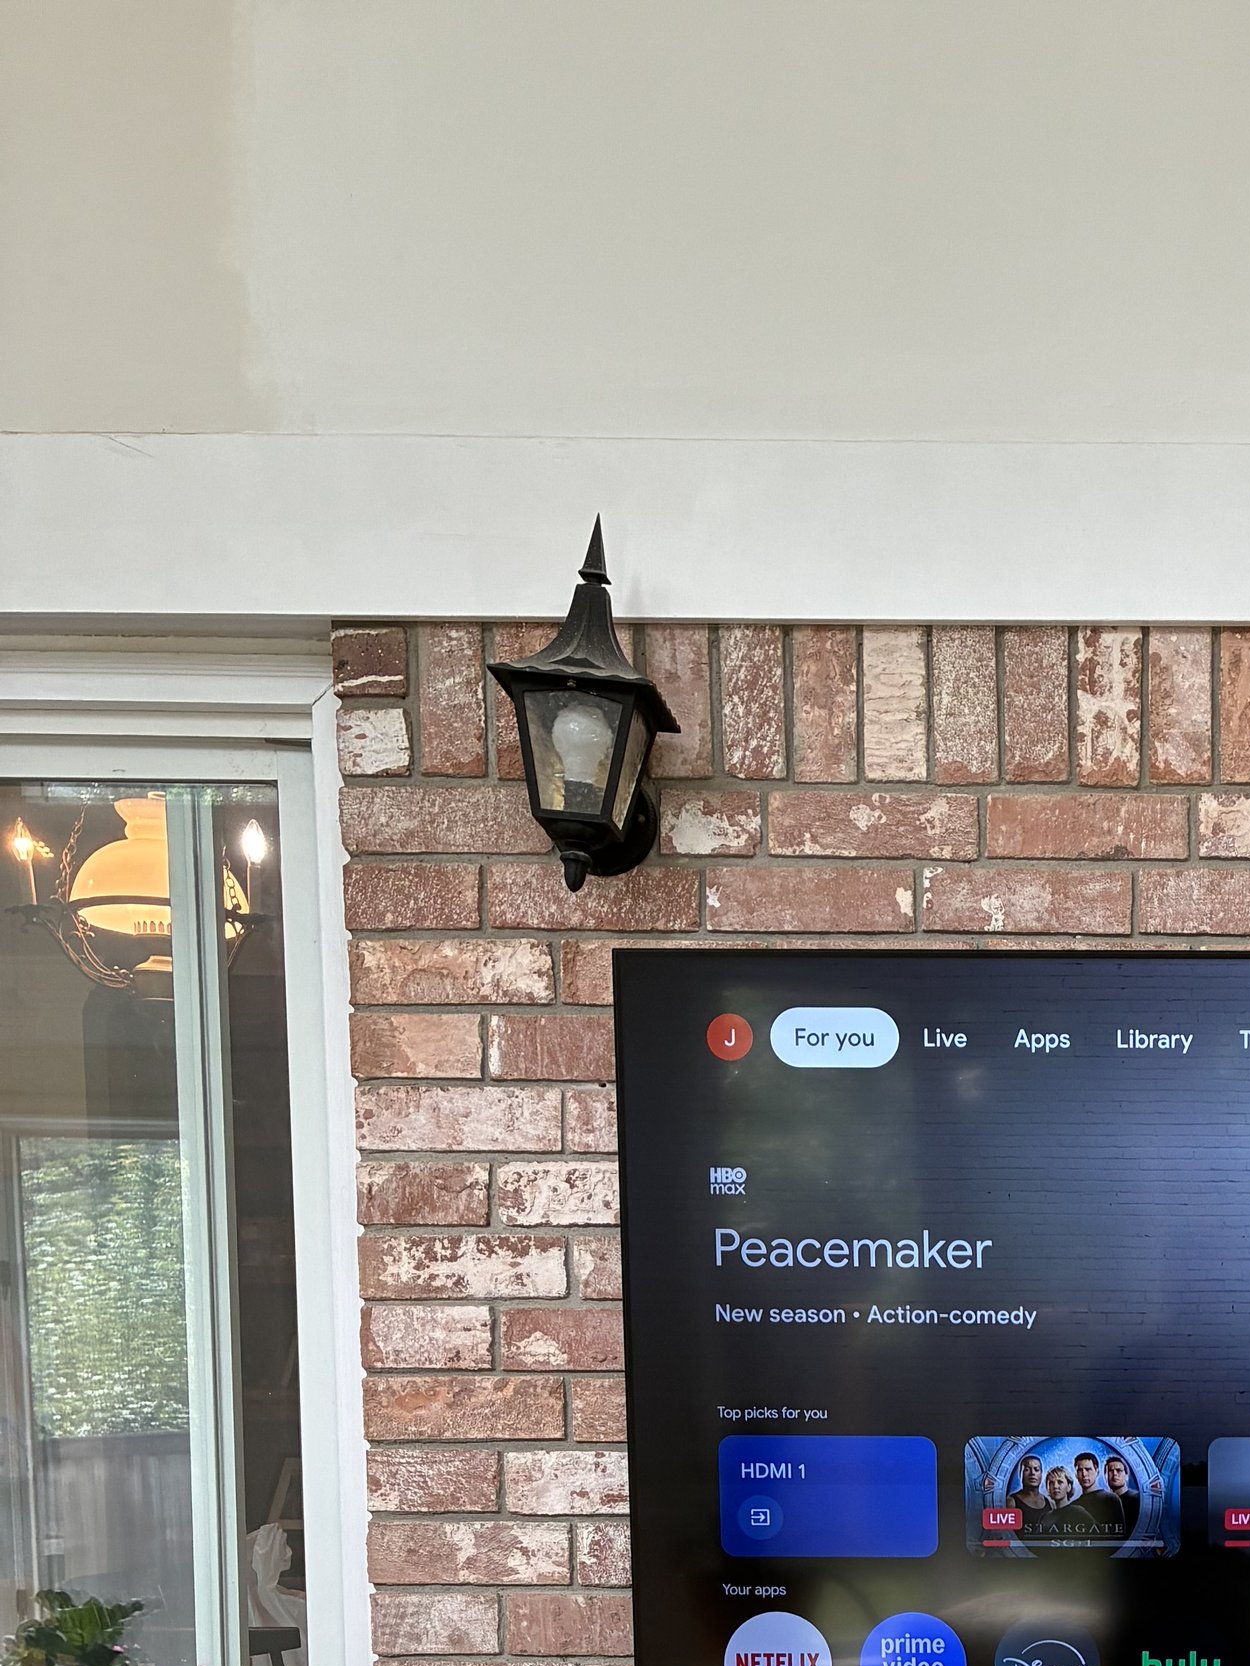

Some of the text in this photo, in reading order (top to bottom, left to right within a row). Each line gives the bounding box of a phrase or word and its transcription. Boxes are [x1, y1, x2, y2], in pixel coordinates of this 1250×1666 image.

[724, 1028, 736, 1047] J
[795, 1028, 875, 1051] For you
[923, 1028, 968, 1048] Live
[1014, 1029, 1071, 1054] Apps
[1116, 1029, 1194, 1054] Library
[710, 1167, 747, 1183] HBO
[710, 1183, 746, 1195] max
[715, 1229, 993, 1269] Peacemaker
[715, 1304, 1037, 1329] New season Action-comedy
[717, 1406, 828, 1422] Top picks for you
[741, 1462, 806, 1479] HDMI 1
[989, 1513, 1016, 1525] LIVE
[1024, 1523, 1124, 1533] STARGATE
[722, 1583, 787, 1598] Your apps
[880, 1632, 946, 1658] prime
